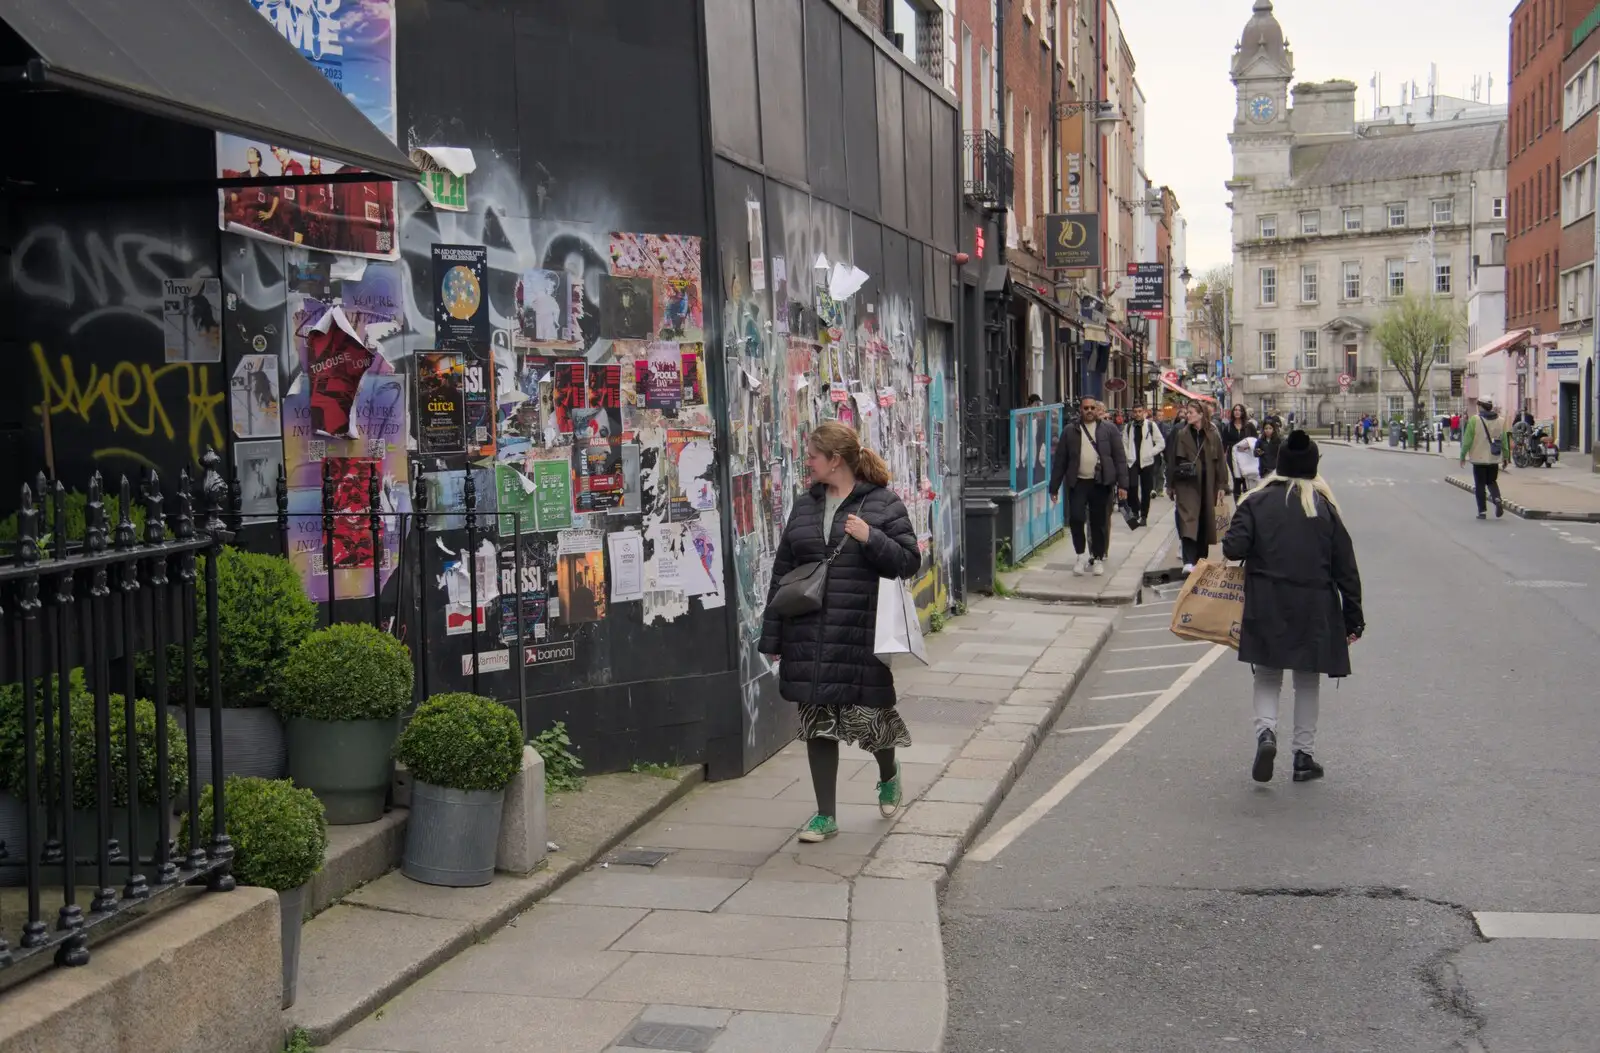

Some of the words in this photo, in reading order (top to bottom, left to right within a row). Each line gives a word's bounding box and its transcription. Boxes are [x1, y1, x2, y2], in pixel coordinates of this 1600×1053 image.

[1065, 153, 1080, 213] ideout
[310, 353, 351, 374] TOLOUSE
[427, 398, 454, 412] circa
[580, 448, 588, 475] FERIA
[1200, 588, 1245, 603] Reusable
[537, 647, 573, 661] bannon
